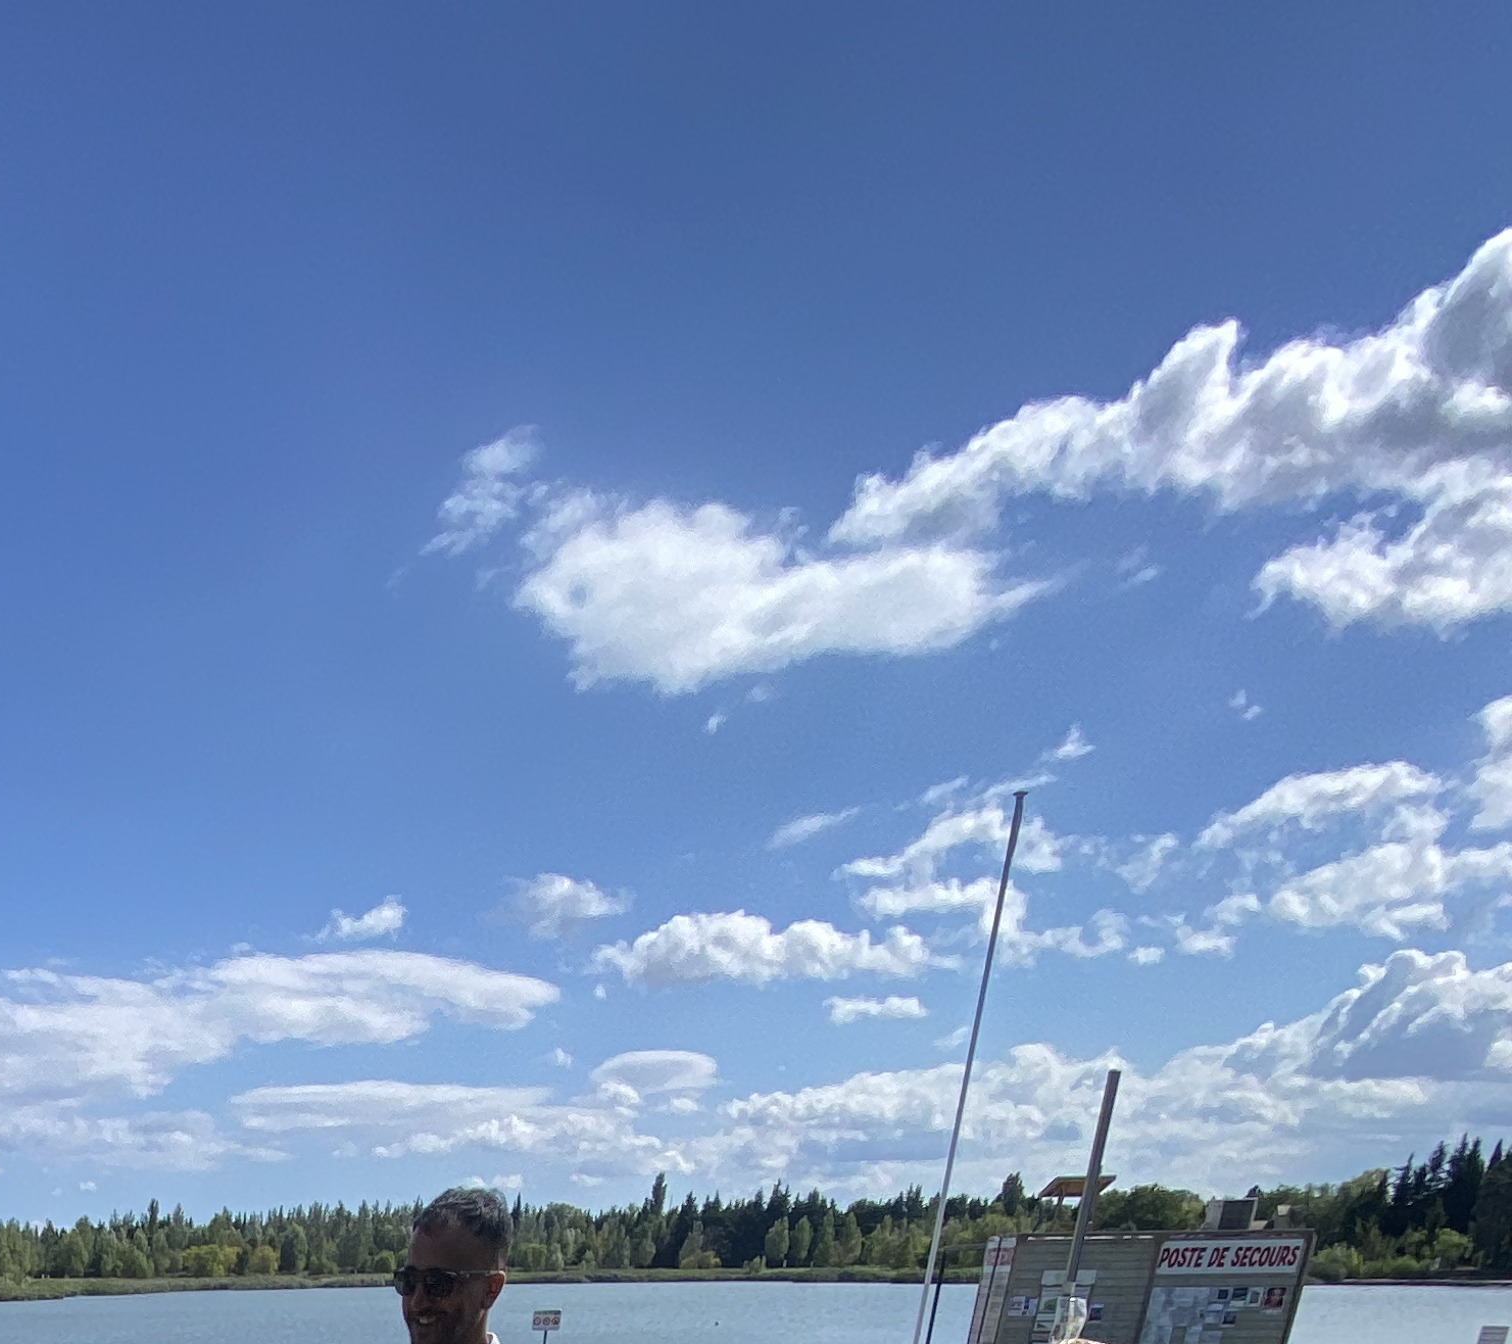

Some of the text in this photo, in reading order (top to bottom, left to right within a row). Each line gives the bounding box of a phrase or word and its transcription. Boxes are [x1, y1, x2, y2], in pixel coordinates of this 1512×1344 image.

[1158, 1245, 1300, 1268] POSTE DE SECOURS
